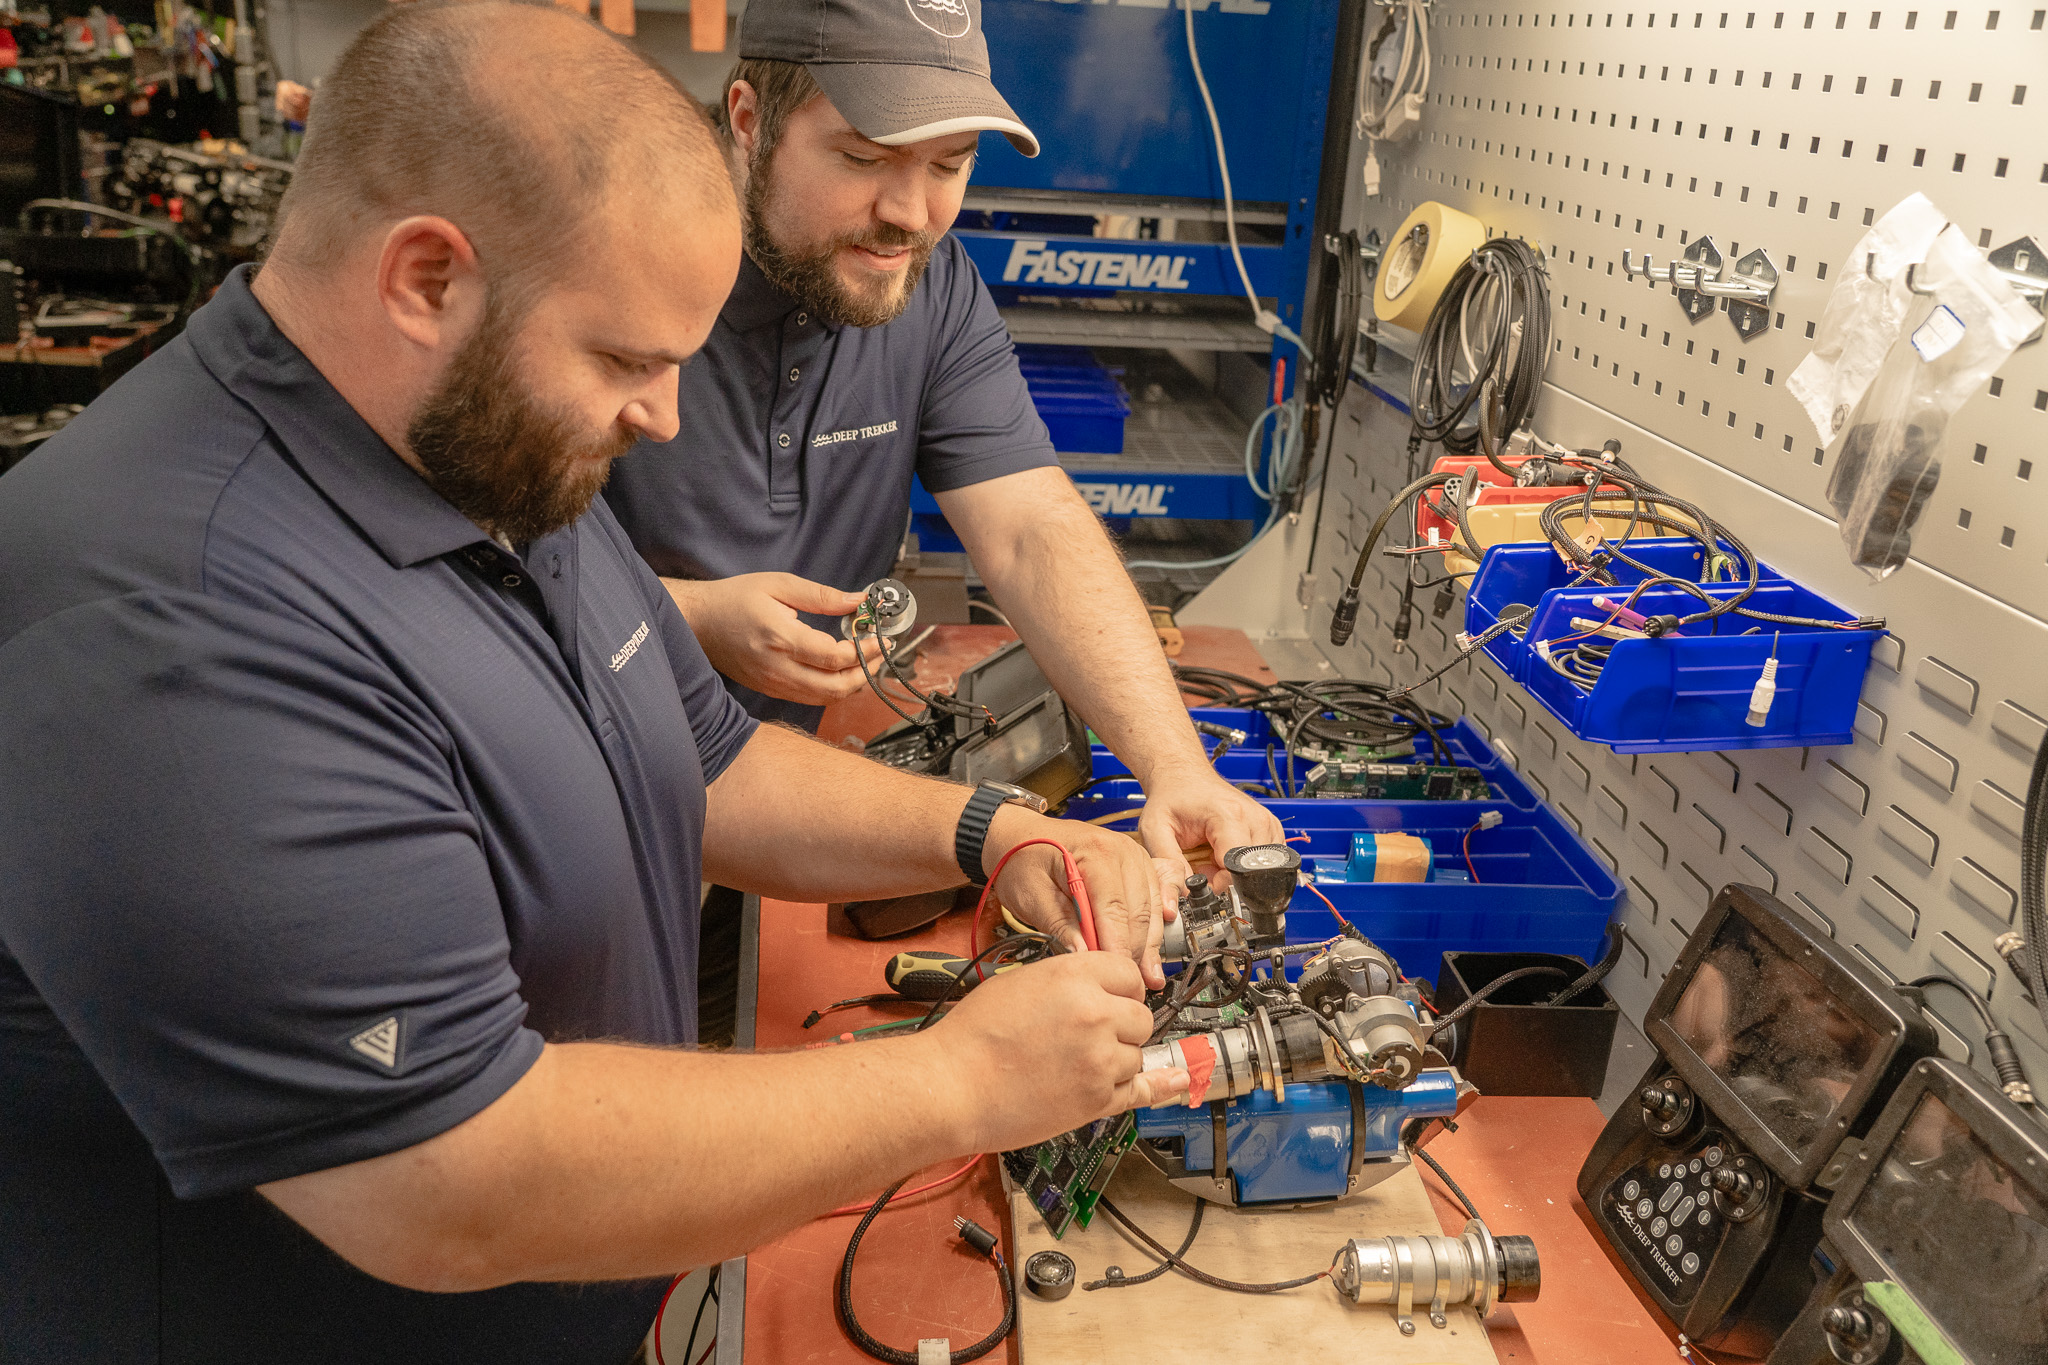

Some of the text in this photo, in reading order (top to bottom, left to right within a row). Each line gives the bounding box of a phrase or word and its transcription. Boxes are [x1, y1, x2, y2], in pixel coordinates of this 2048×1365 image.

[1002, 240, 1190, 290] FASTENAL
[832, 420, 898, 443] DEEP TREKKER
[1074, 483, 1168, 515] ENAL
[1632, 1224, 1681, 1286] DEEP TREKKER
